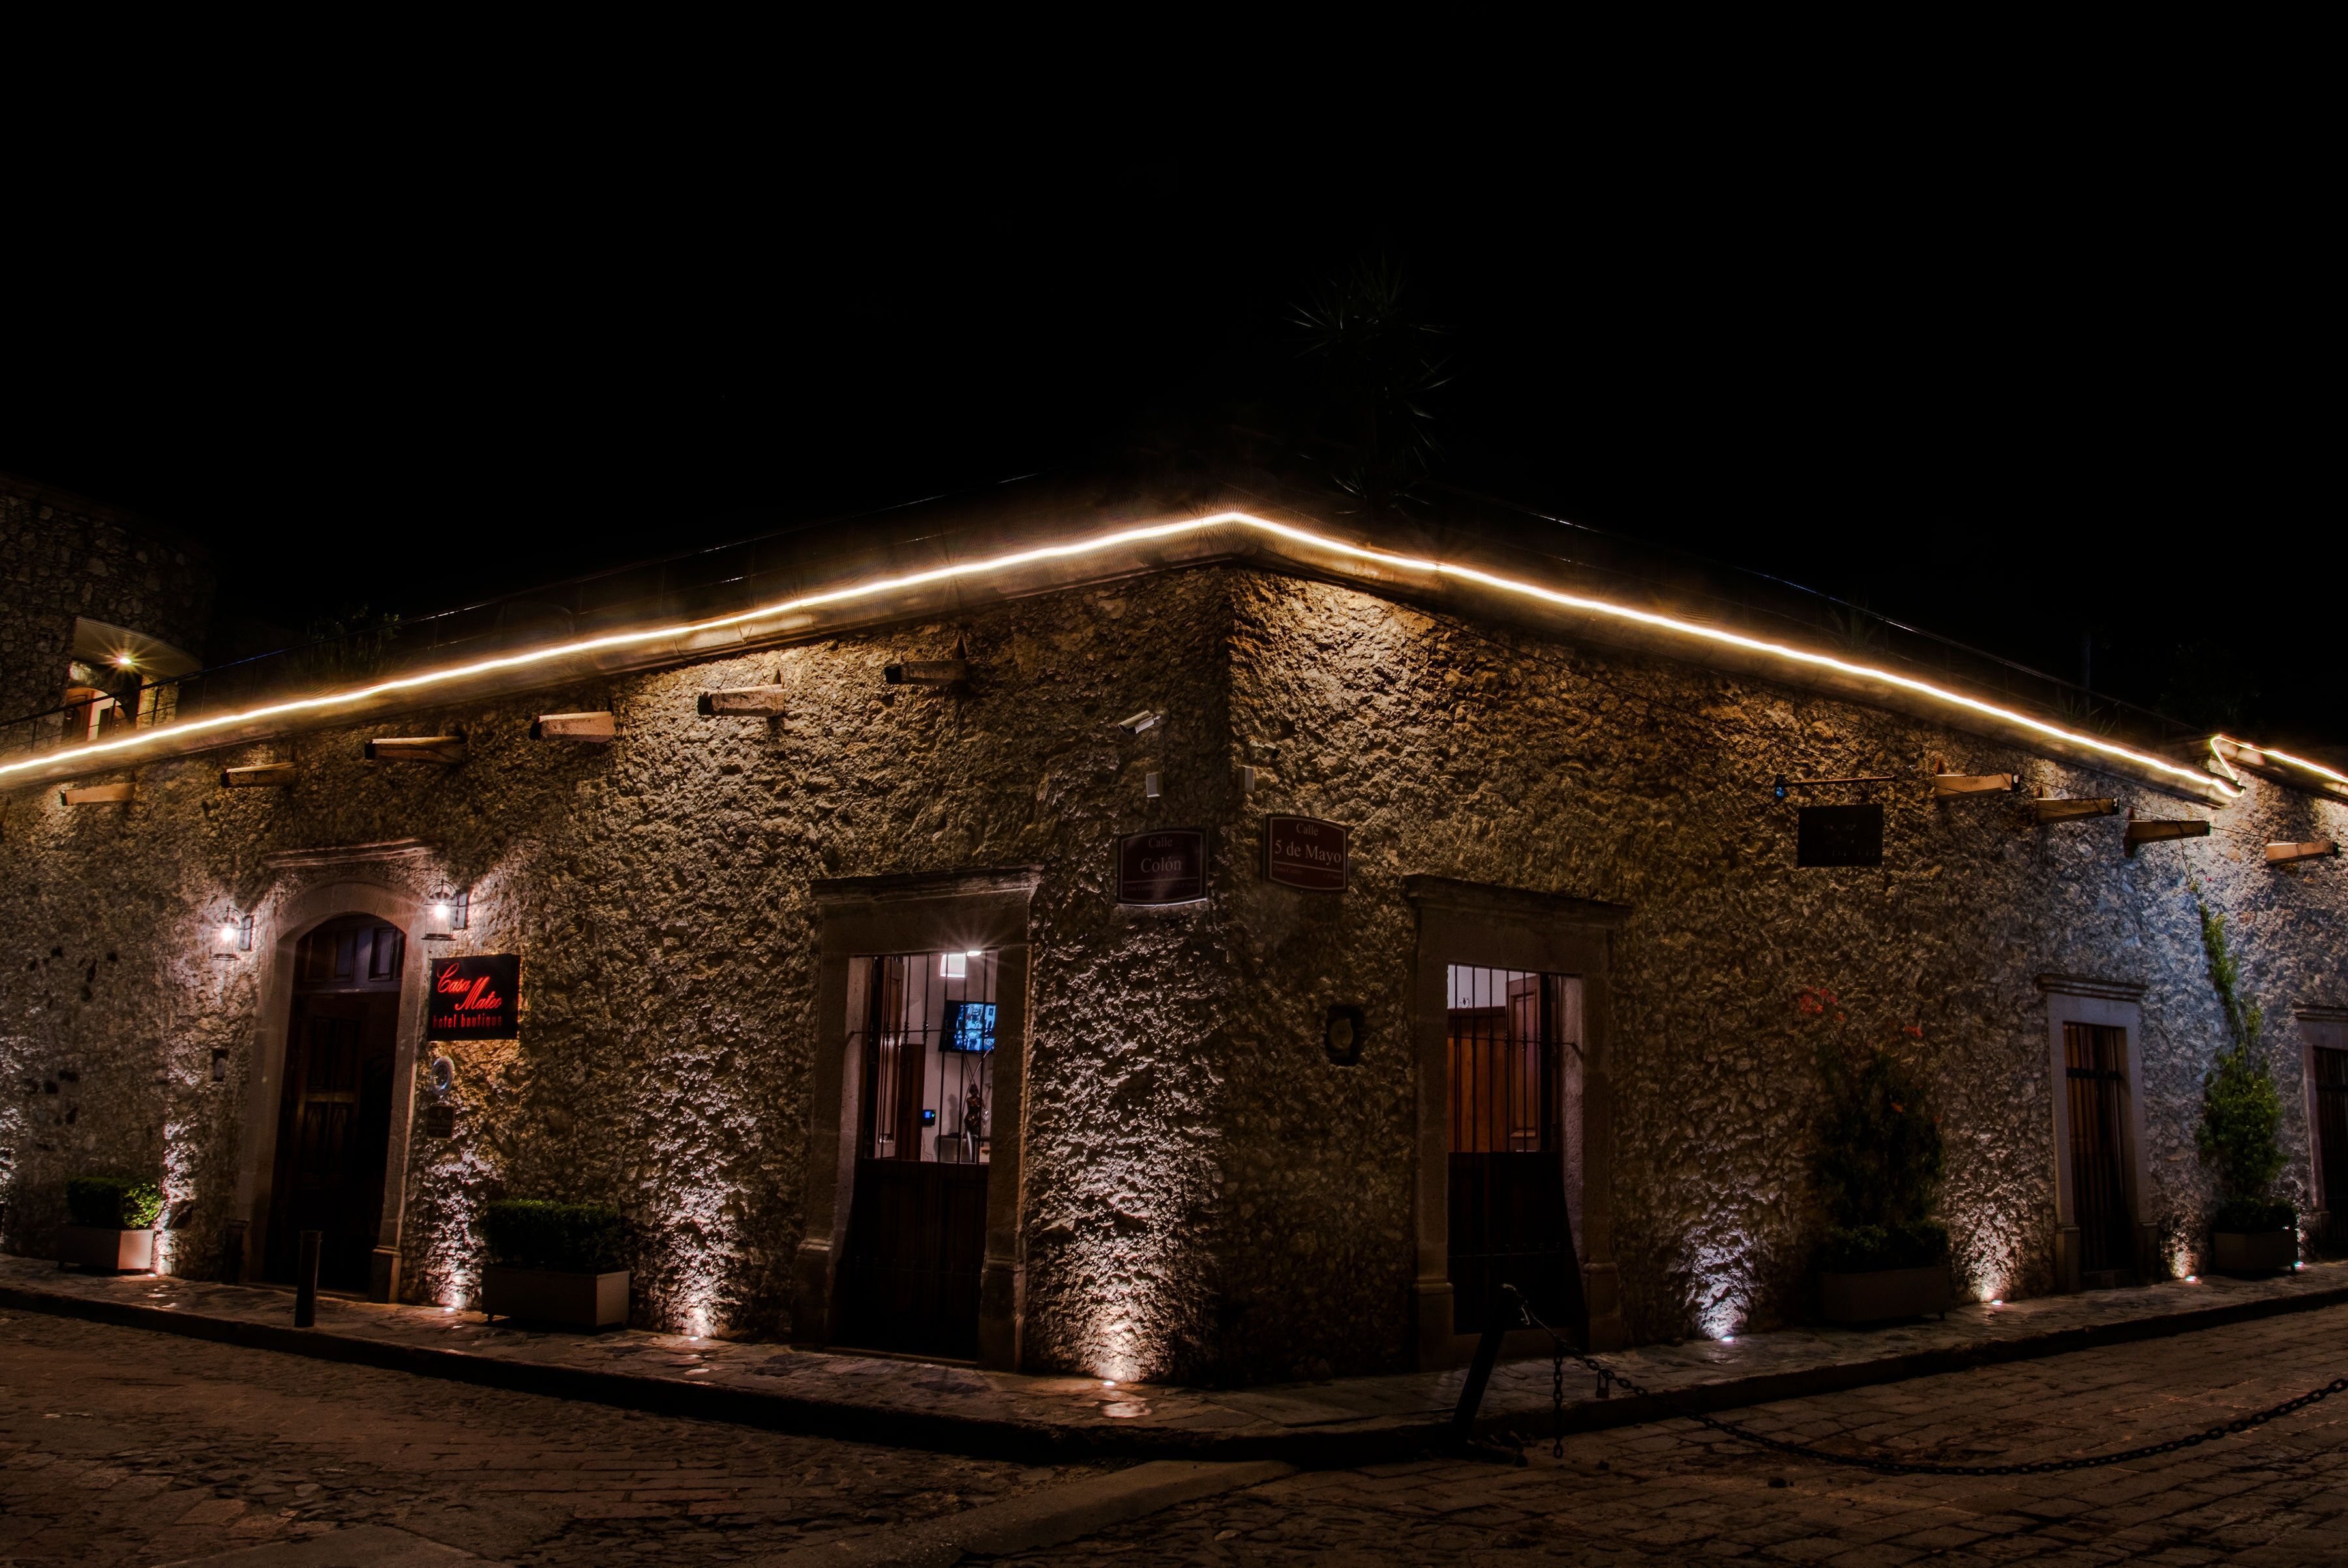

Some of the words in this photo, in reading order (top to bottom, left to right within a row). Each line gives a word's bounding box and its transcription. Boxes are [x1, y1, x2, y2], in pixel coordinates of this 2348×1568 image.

[1296, 823, 1318, 837] Calle
[1149, 836, 1173, 849] Calle
[1274, 839, 1283, 854] 5
[1286, 841, 1301, 858] de
[1305, 844, 1342, 866] Mayo
[1140, 856, 1181, 874] Colón
[436, 961, 472, 993] Casa
[454, 975, 502, 1012] Mateo
[432, 1014, 457, 1029] hotel
[461, 1012, 502, 1030] boutique
